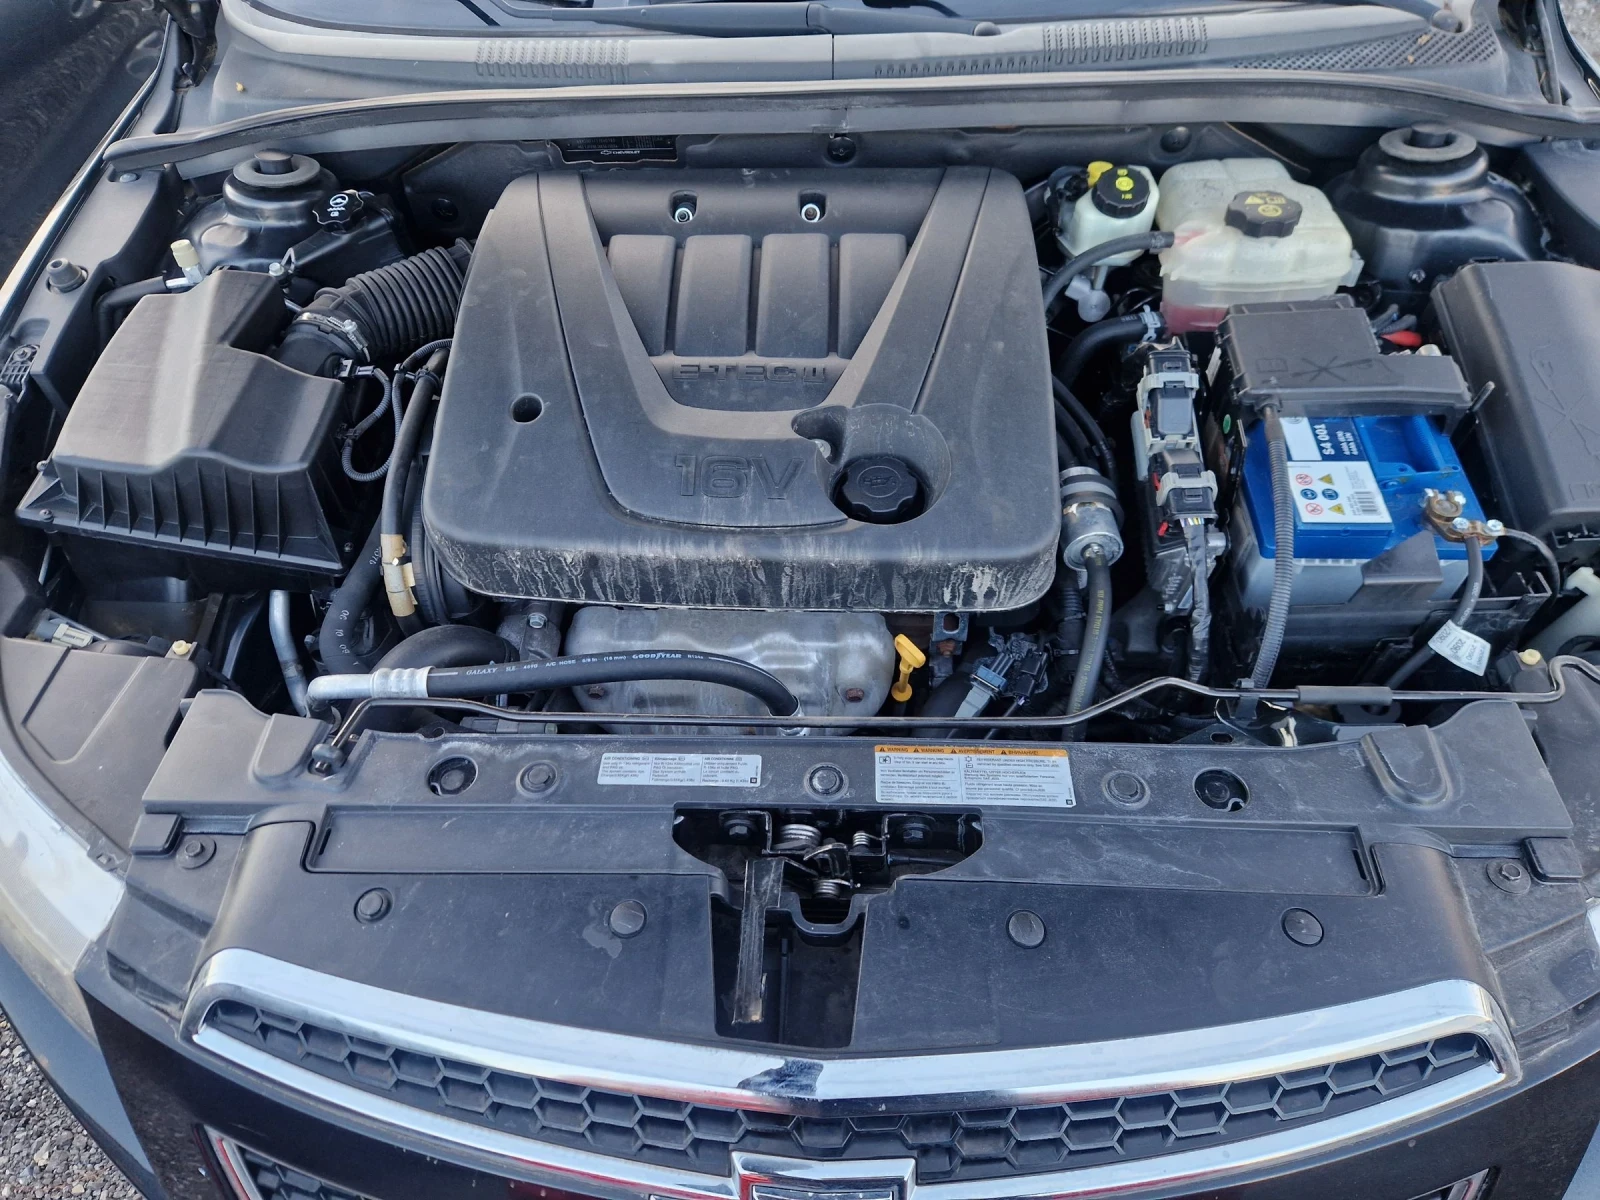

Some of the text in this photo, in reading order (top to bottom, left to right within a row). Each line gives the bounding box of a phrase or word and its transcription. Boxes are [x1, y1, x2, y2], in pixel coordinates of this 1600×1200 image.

[1313, 423, 1335, 455] S4 001
[675, 454, 806, 499] 16V
[466, 667, 498, 676] GALAXY
[632, 651, 682, 660] GOODYEAR
